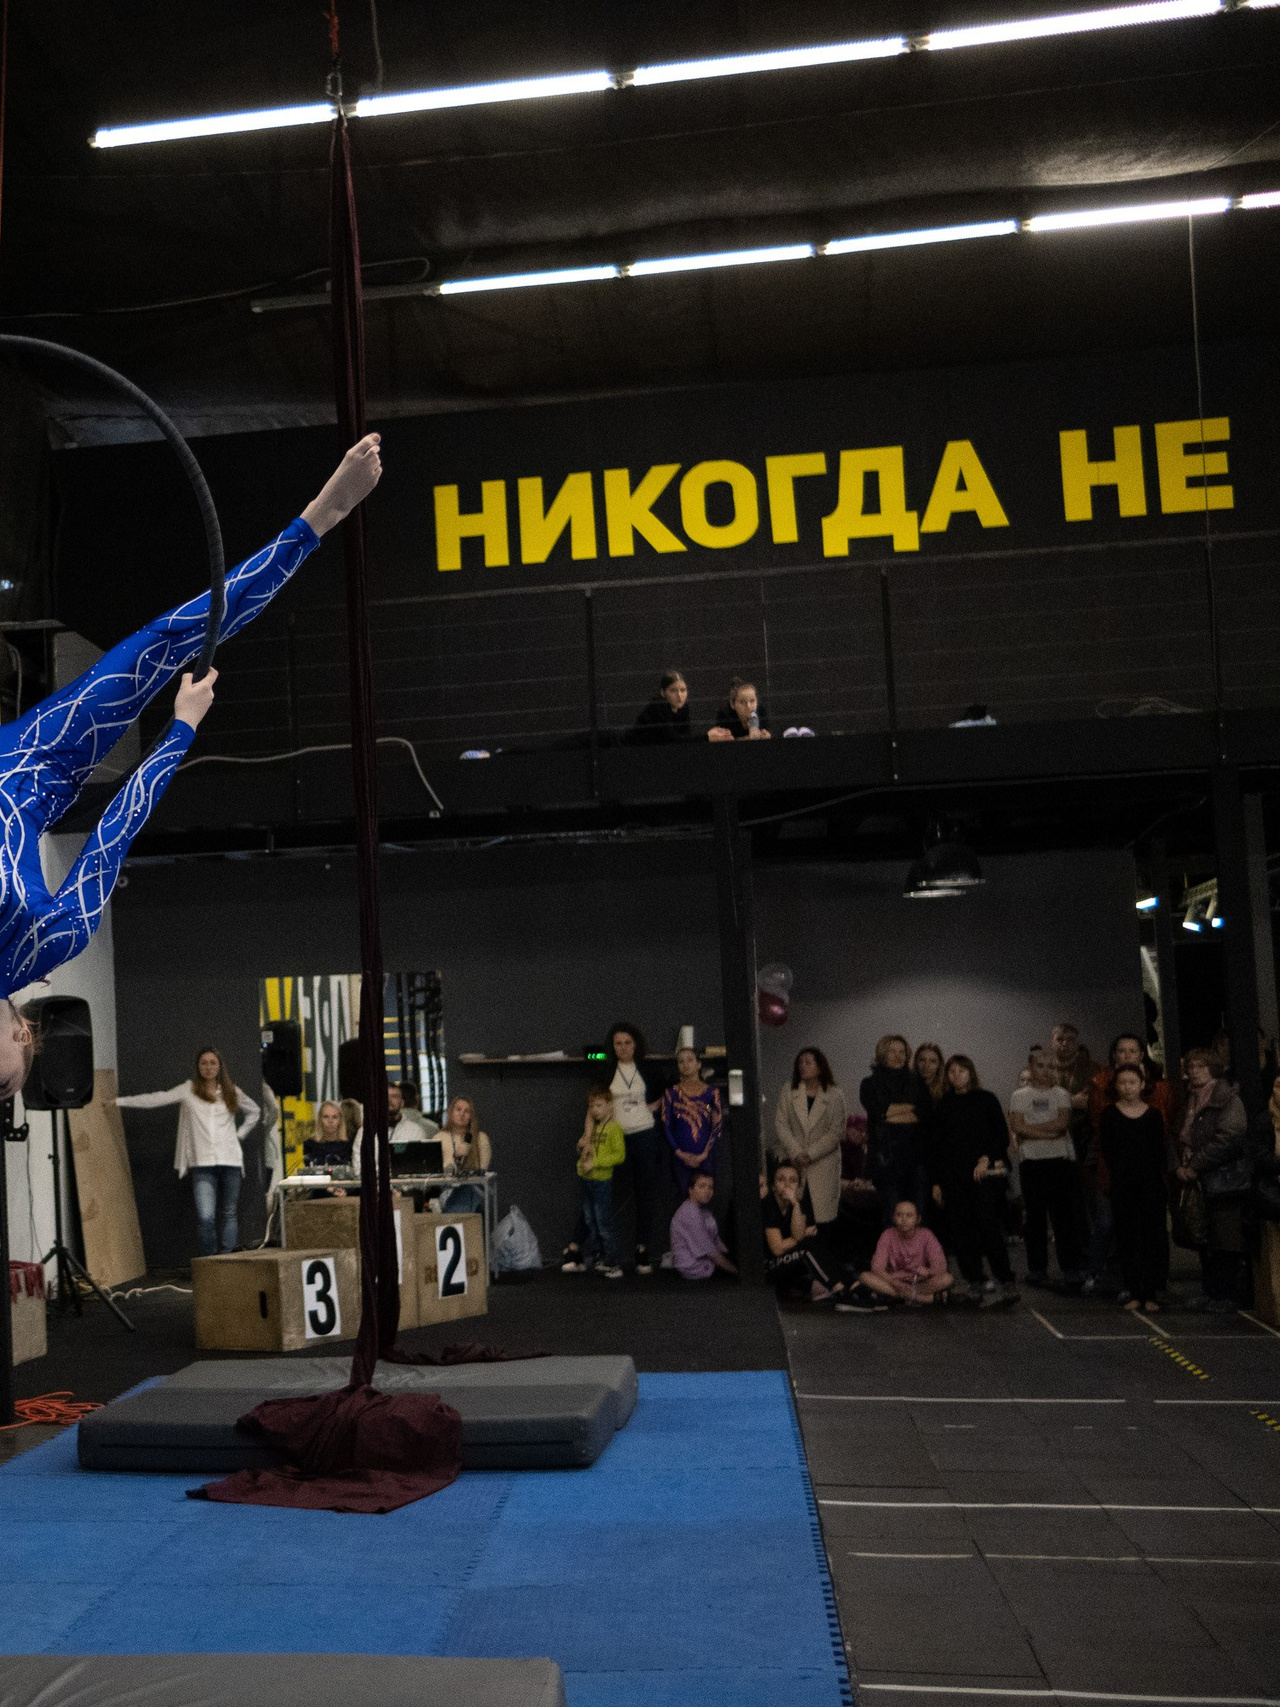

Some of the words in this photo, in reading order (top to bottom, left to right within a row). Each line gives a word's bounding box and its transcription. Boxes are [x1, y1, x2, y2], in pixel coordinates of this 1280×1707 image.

[433, 439, 1010, 571] НИКОГДА
[1059, 416, 1234, 522] НЕ
[306, 1260, 336, 1335] 3
[439, 1226, 465, 1297] 2
